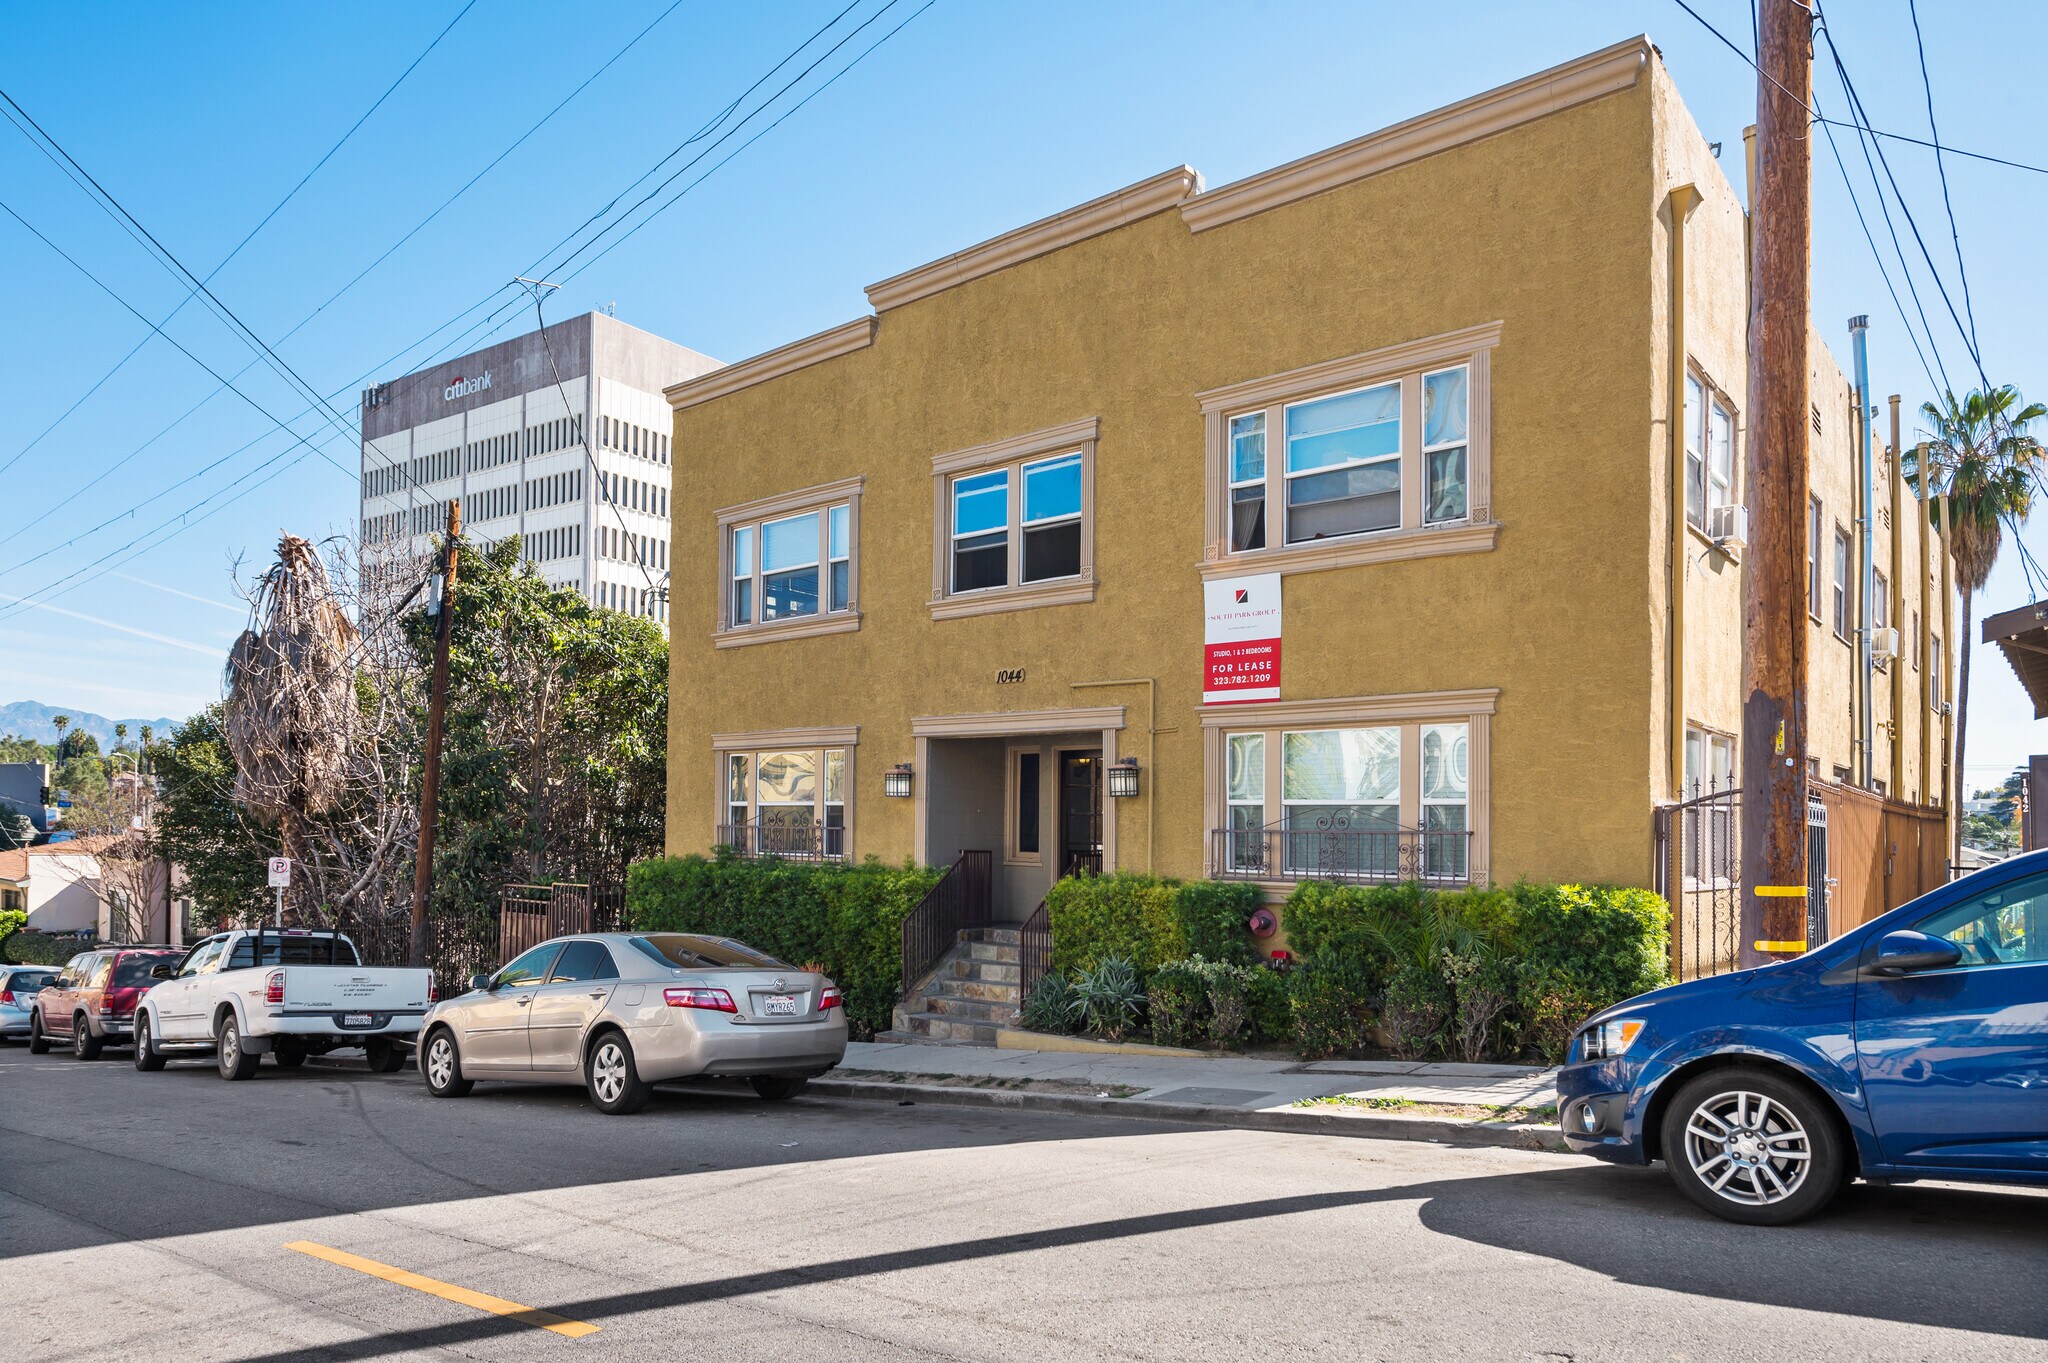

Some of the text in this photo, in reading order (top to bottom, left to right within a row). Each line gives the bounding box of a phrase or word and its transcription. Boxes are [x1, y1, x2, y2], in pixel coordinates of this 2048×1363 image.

[444, 370, 492, 401] citibank
[1211, 608, 1276, 621] SOUTH PARK GROUP
[1245, 646, 1272, 655] BEDROOMS
[1212, 660, 1272, 673] FOR LEASE
[996, 669, 1022, 684] 1044
[1213, 673, 1271, 685] 323.782.1209
